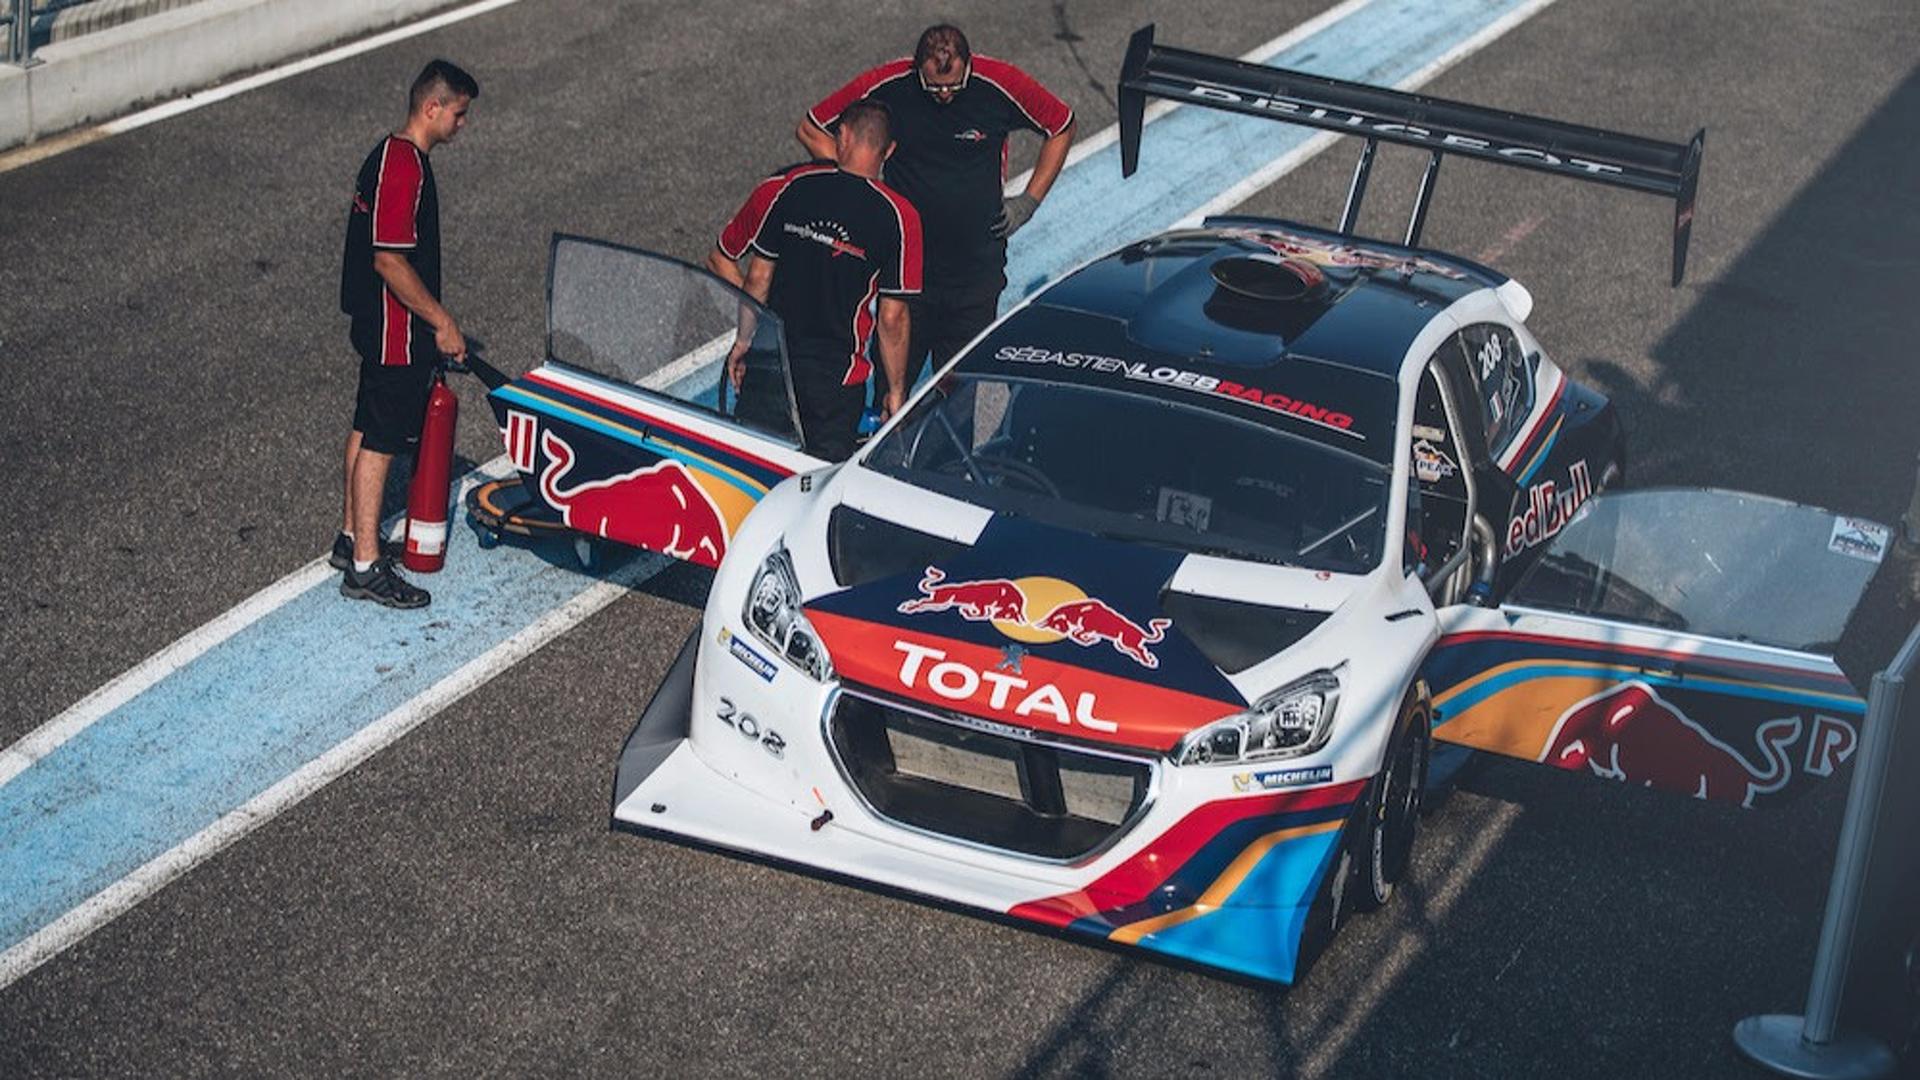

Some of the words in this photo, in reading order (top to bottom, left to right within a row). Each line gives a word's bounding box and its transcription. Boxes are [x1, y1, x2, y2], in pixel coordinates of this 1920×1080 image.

[1478, 333, 1502, 380] 208
[894, 639, 1118, 733] TOTAL
[716, 696, 786, 760] 208
[1263, 768, 1331, 787] MICHELIN
